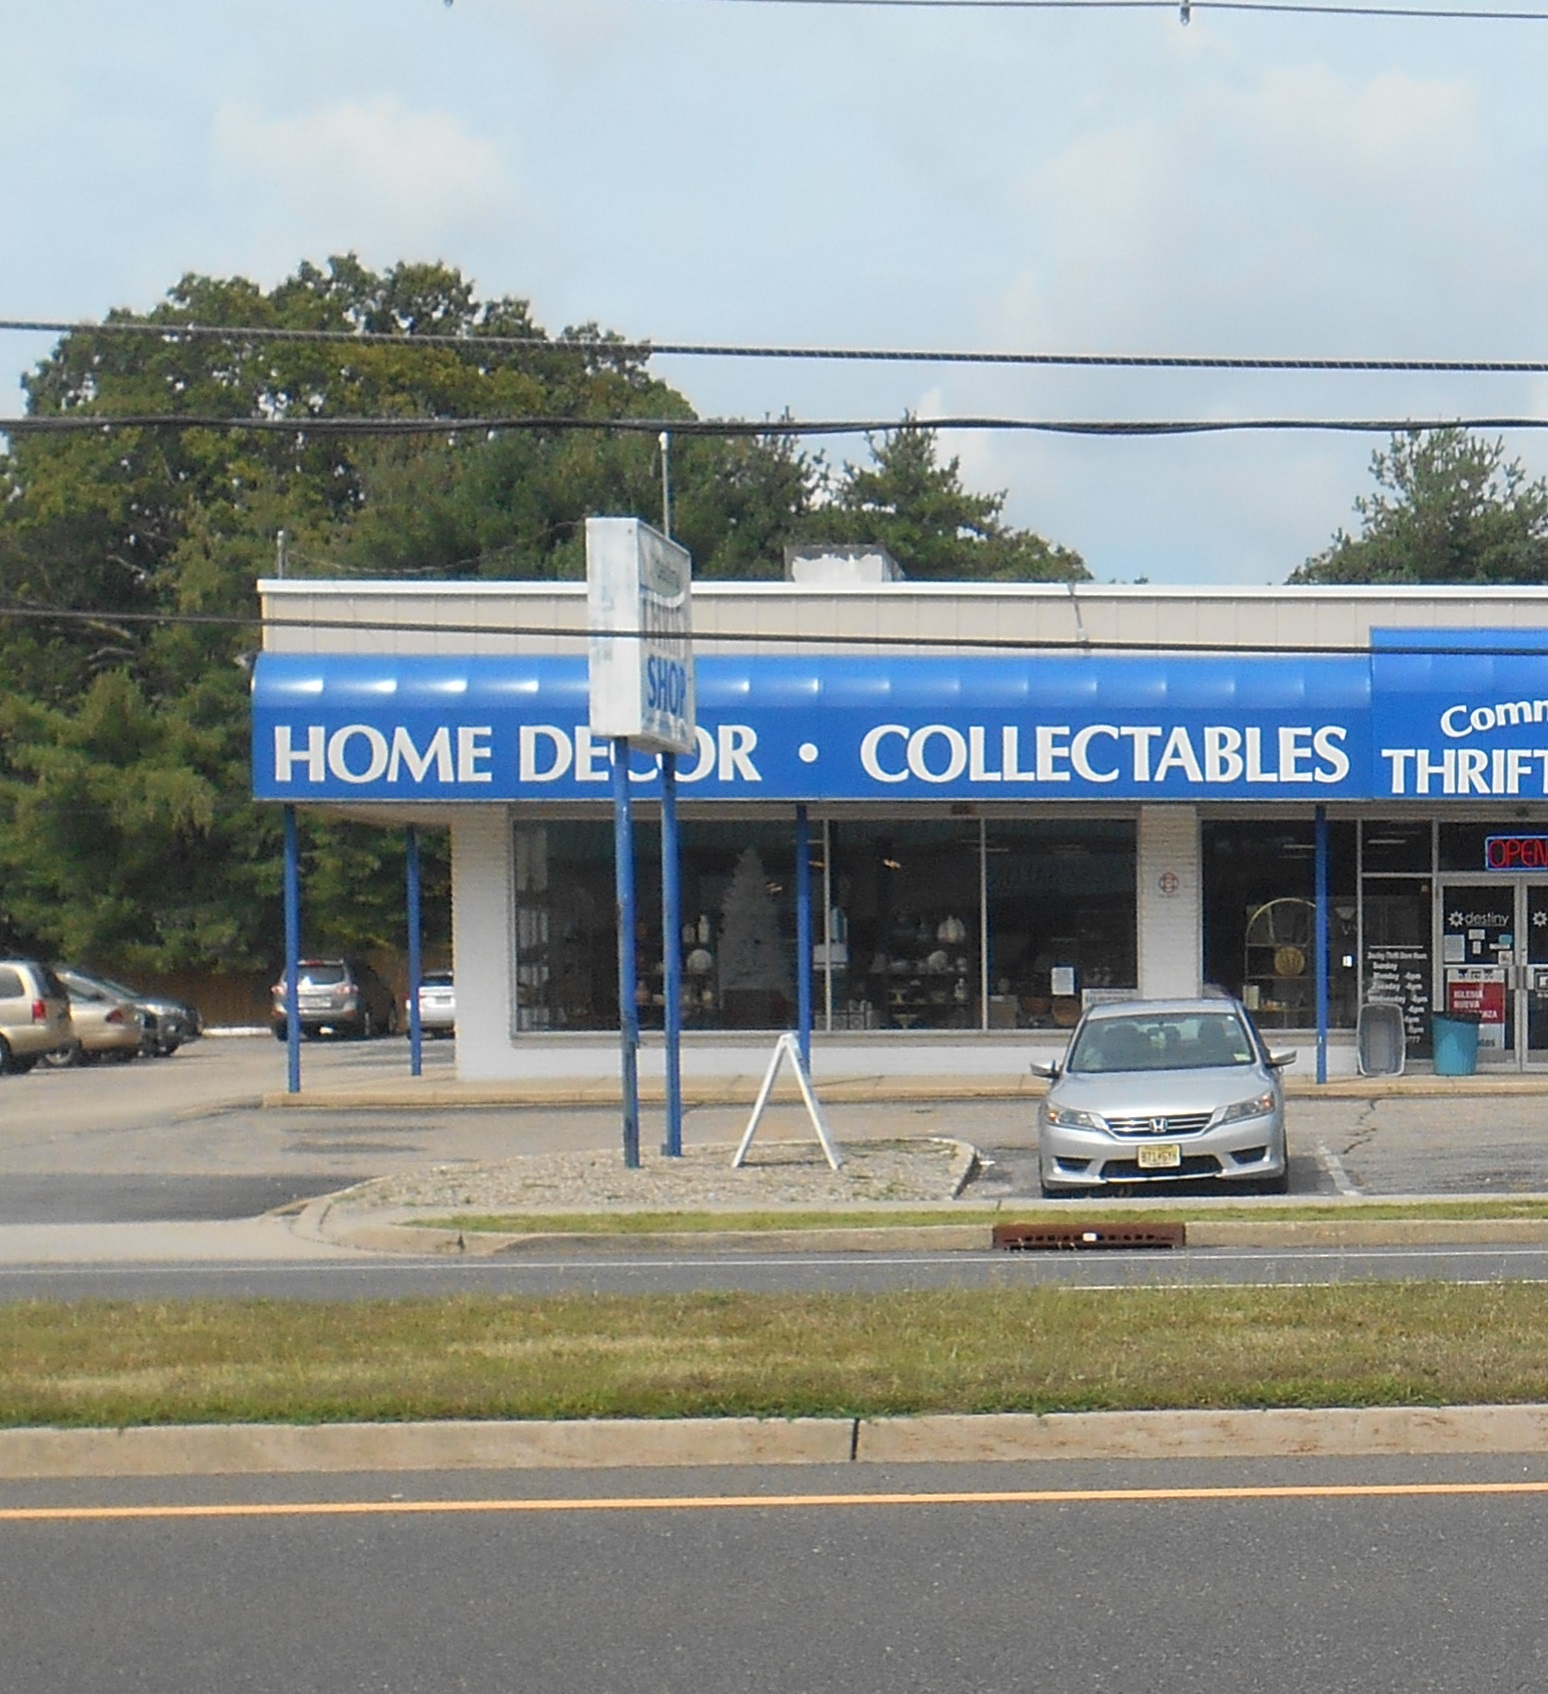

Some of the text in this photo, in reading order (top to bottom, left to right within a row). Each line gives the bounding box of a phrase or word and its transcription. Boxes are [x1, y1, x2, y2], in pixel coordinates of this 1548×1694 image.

[648, 655, 686, 717] SHOP
[274, 725, 492, 783] HOME
[860, 724, 1350, 784] COLLECTABLES
[1464, 911, 1509, 926] destiny
